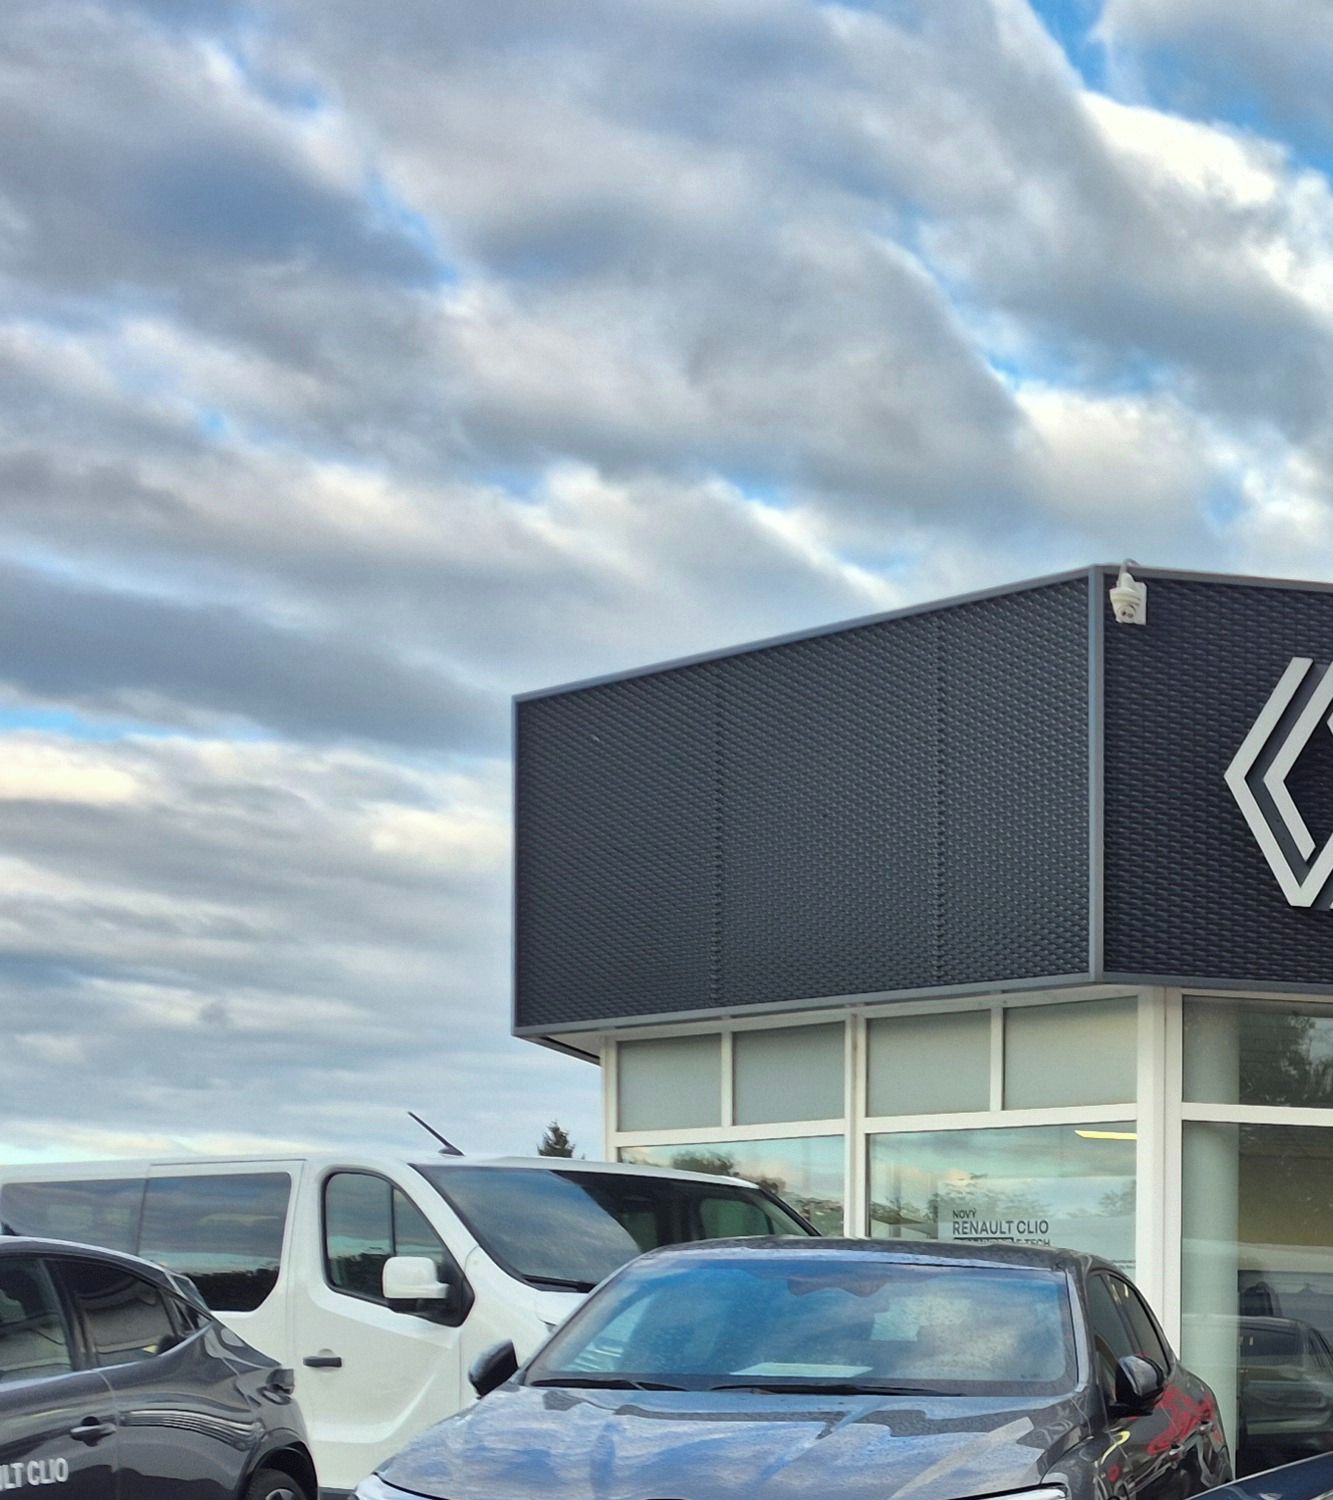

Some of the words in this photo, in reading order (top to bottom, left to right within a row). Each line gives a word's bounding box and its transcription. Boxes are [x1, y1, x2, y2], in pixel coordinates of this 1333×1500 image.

[952, 1220, 1012, 1235] RENAULT
[1016, 1219, 1049, 1234] CLIO
[0, 1463, 24, 1491] LT
[27, 1458, 69, 1487] CLIO
